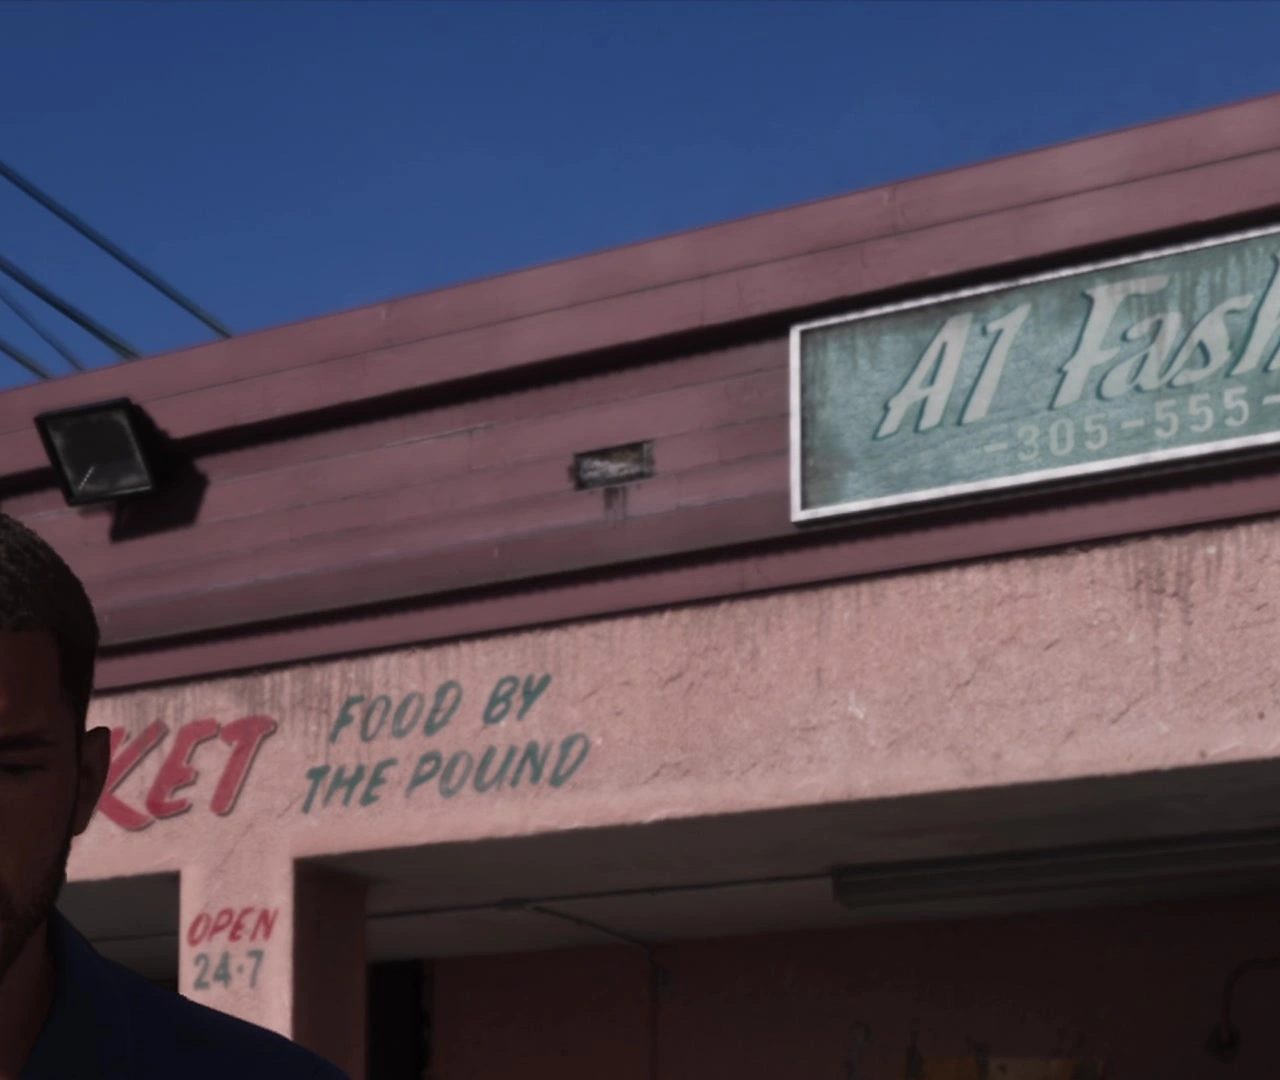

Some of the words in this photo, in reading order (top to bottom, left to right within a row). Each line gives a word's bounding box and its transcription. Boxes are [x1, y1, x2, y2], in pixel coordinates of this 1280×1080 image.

[876, 304, 1030, 440] A1
[329, 679, 464, 744] FOOD
[482, 673, 552, 727] BY
[97, 714, 278, 831] KET
[301, 757, 399, 815] THE
[404, 732, 592, 799] POUND
[186, 906, 280, 948] OPEN
